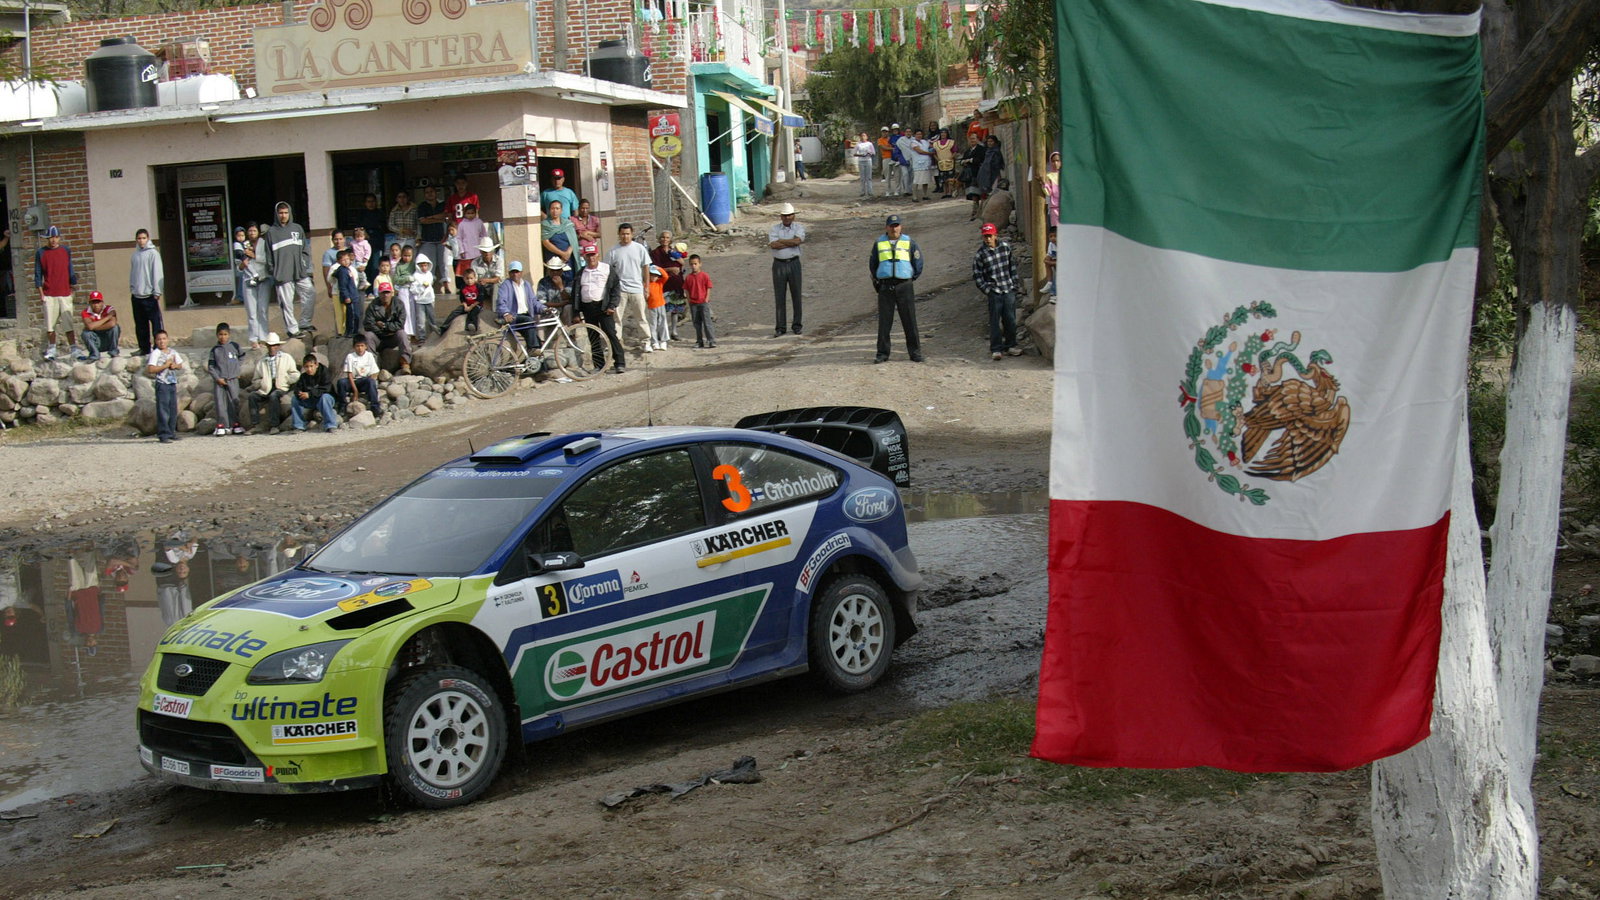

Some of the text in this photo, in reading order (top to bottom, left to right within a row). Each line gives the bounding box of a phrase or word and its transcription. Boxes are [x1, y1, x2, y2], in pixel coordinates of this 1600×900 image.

[272, 30, 513, 82] LA CANTERA
[110, 169, 123, 178] 102
[712, 464, 753, 513] 3
[763, 471, 839, 501] Grönholm
[854, 493, 890, 519] Ford
[704, 519, 789, 554] KÄRCHER
[799, 533, 850, 588] BFGoodrich
[544, 585, 561, 616] 3
[568, 578, 621, 604] Corona
[623, 582, 649, 594] PEMEX
[159, 623, 268, 658] ultimate
[589, 619, 704, 688] Castrol
[160, 697, 189, 716] Castrol
[231, 692, 357, 721] ultimate
[234, 690, 248, 700] bp
[283, 720, 357, 738] KÄRCHER
[213, 767, 261, 777] BFGoodrich
